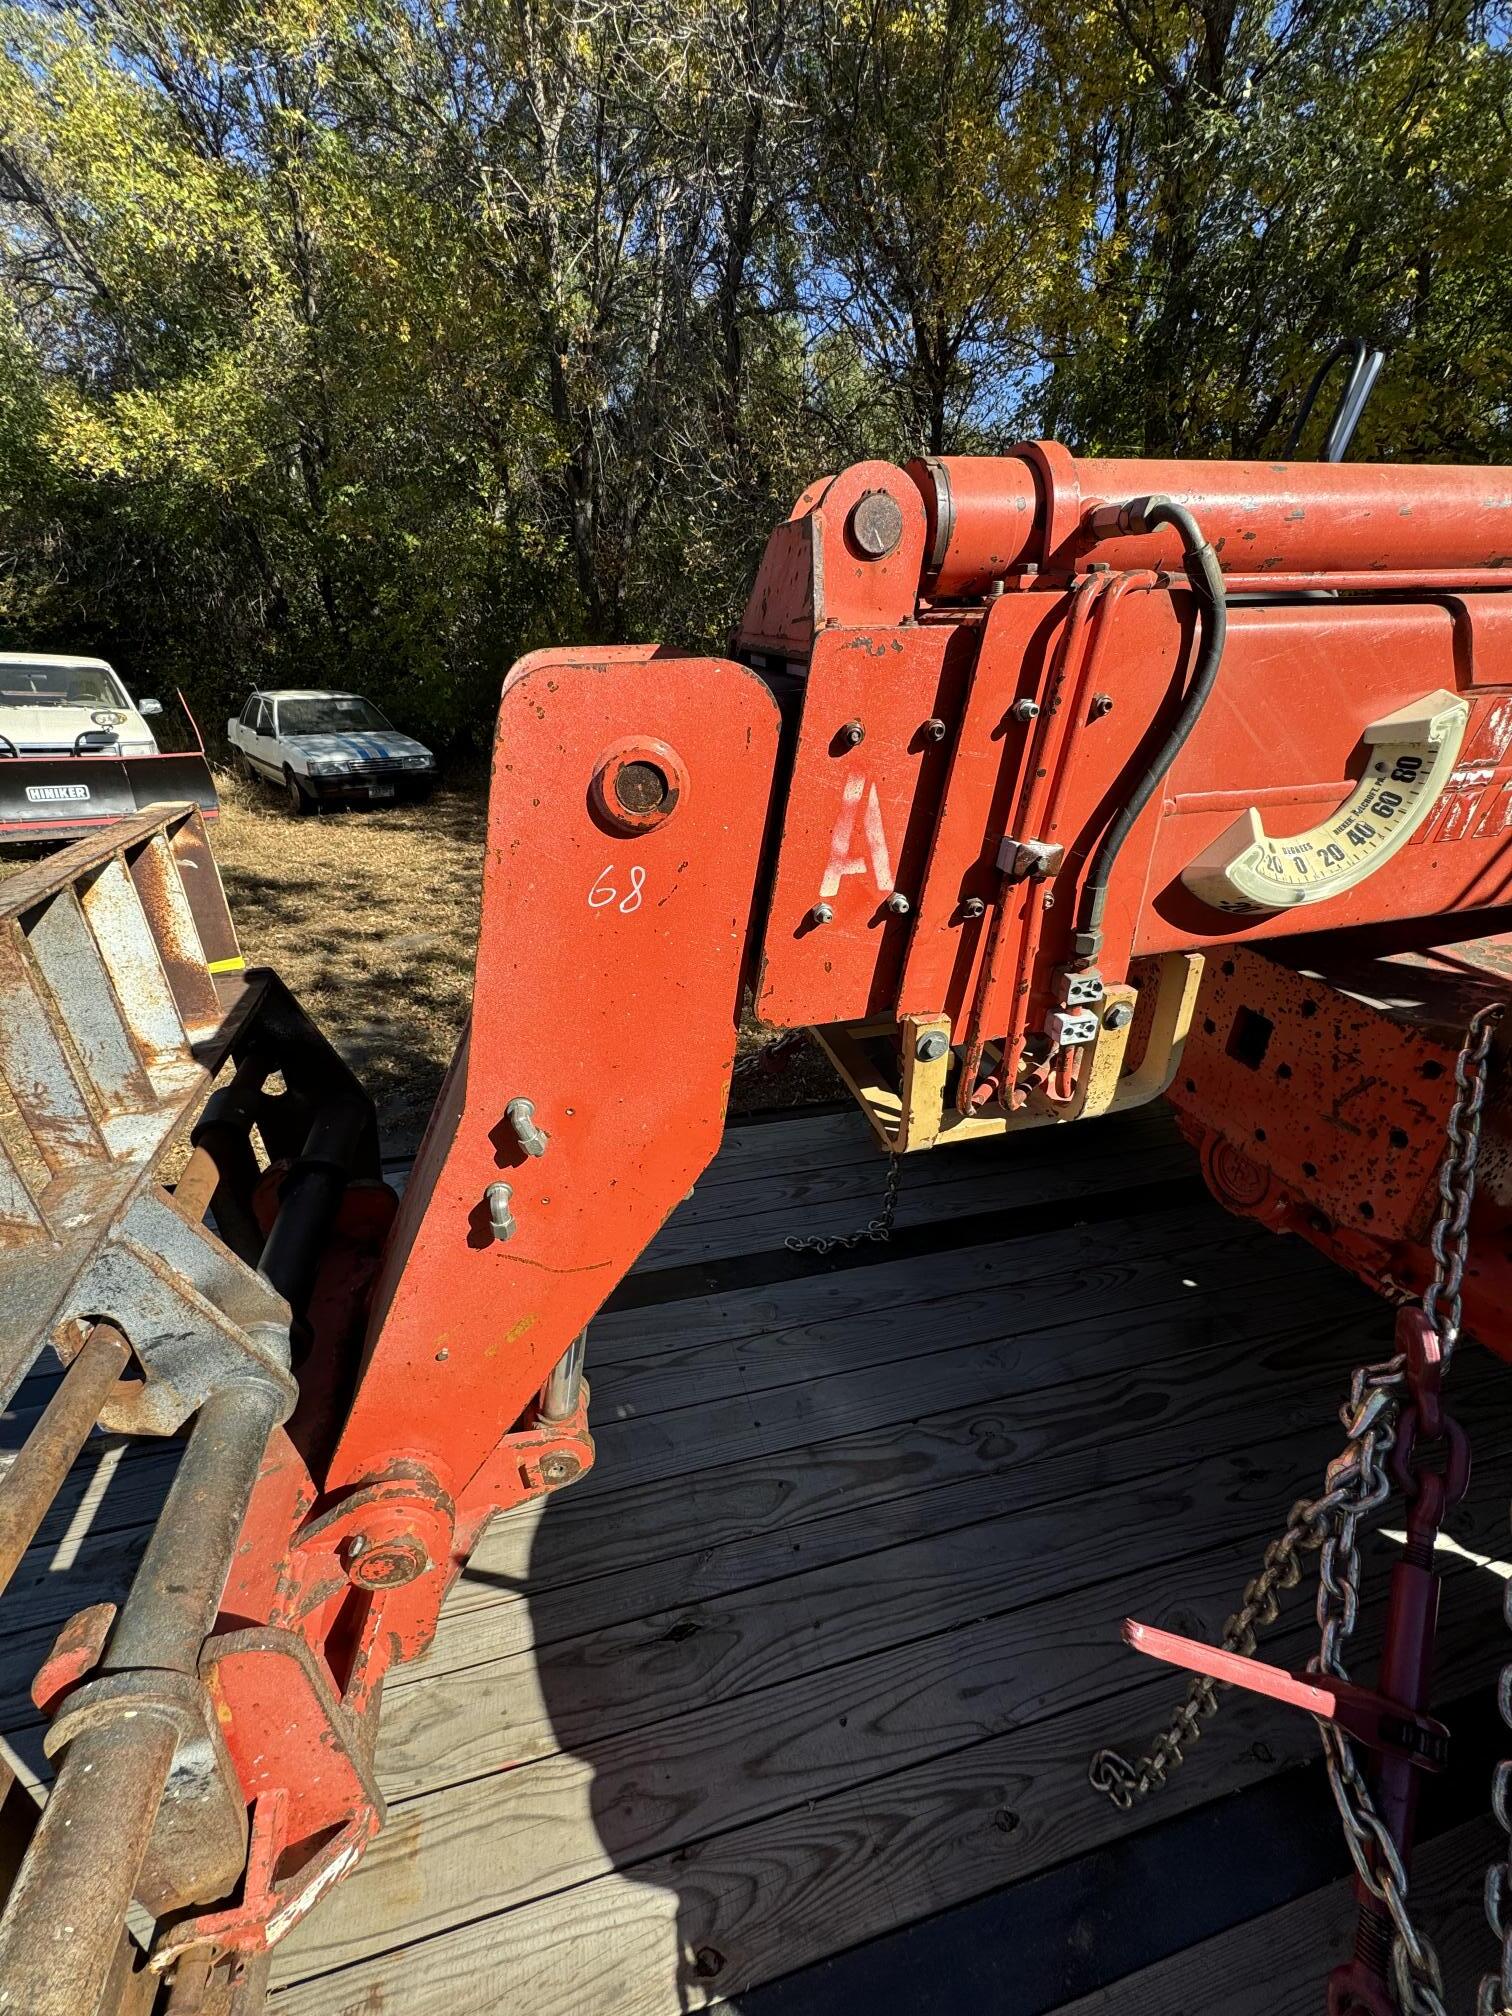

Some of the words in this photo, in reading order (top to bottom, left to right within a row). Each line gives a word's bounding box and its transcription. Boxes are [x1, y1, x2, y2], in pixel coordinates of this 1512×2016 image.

[29, 786, 86, 799] HINIKER
[1293, 856, 1308, 874] 0
[1316, 843, 1345, 867] 20
[1346, 822, 1376, 847] 40
[1371, 791, 1403, 819] 60
[1391, 756, 1422, 783] 80
[819, 773, 895, 898] A
[1282, 842, 1313, 855] DEGREES
[587, 865, 646, 914] 68
